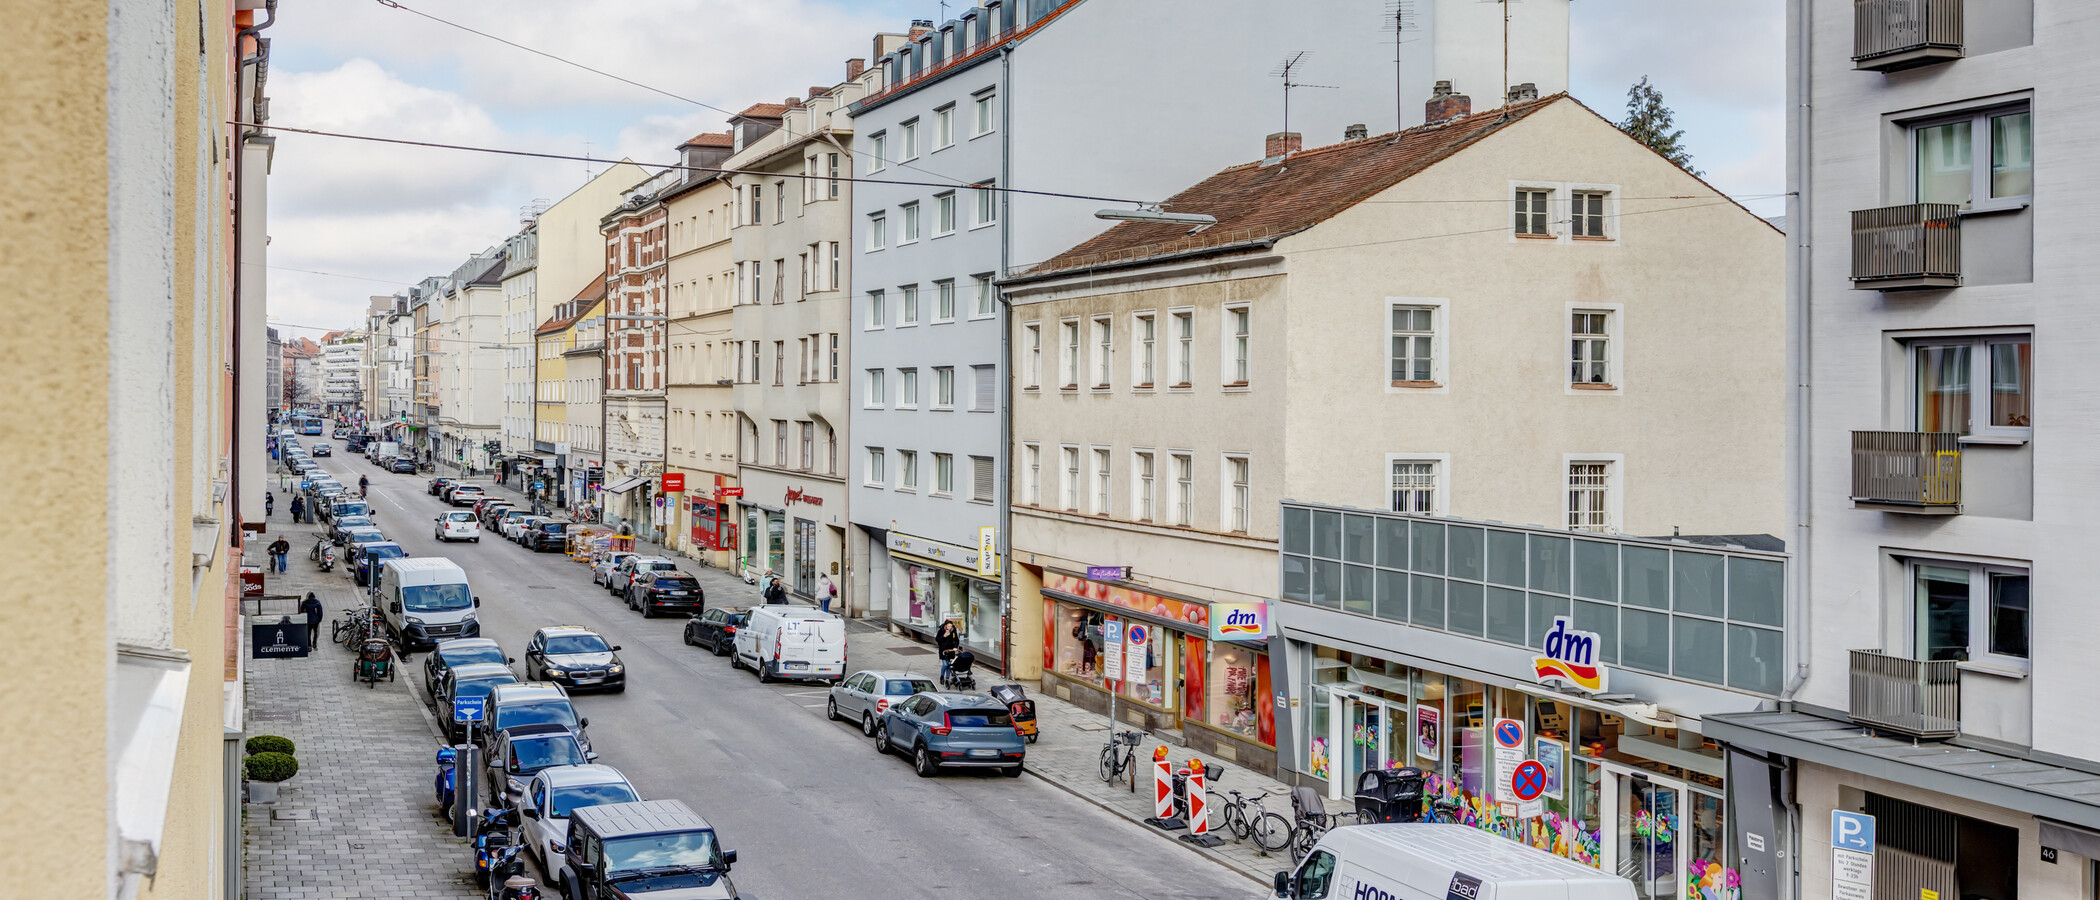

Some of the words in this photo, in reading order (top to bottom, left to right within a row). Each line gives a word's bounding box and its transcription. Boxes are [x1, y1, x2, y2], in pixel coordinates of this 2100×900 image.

[1227, 609, 1256, 625] dm
[1107, 623, 1117, 638] P
[1546, 620, 1592, 665] dm
[1839, 816, 1861, 844] P
[2043, 849, 2055, 859] 46
[1454, 879, 1478, 898] bad
